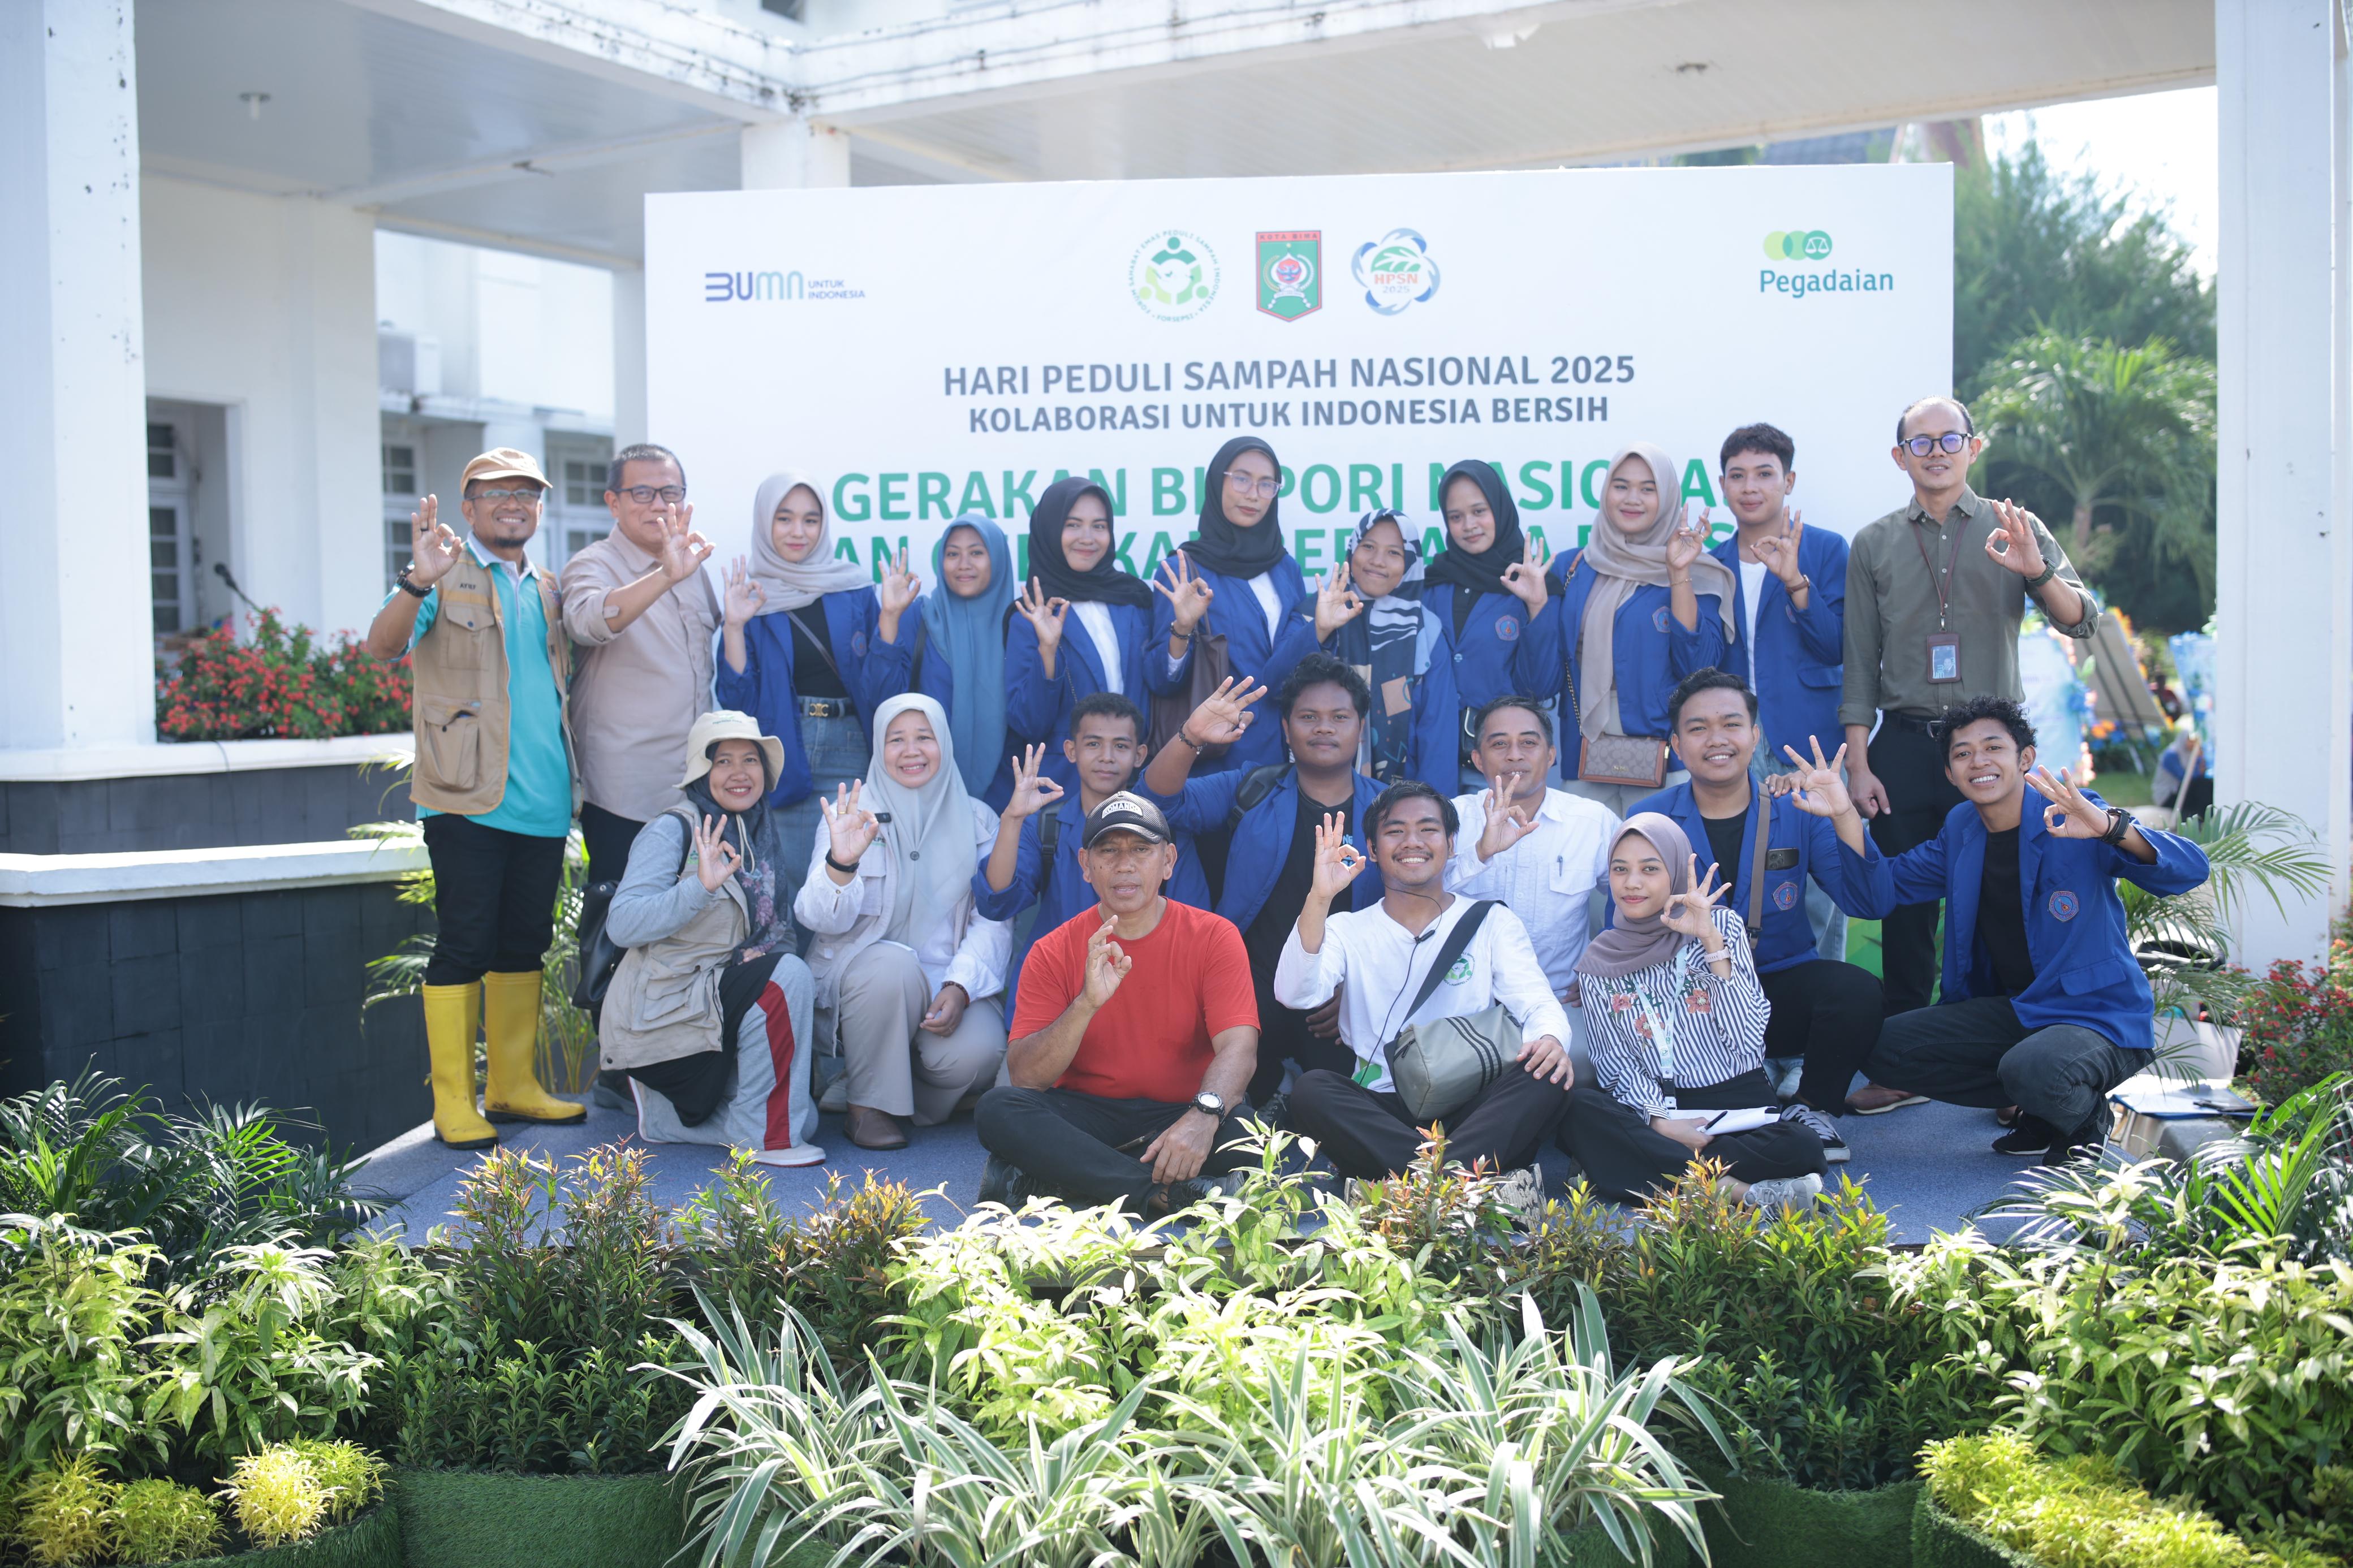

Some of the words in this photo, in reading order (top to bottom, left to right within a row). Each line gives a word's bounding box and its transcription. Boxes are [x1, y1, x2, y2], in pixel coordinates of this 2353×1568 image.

[808, 280, 844, 289] UNTUK
[1162, 229, 1194, 239] PEDULI
[1198, 267, 1220, 312] INDONESIA
[1374, 273, 1419, 284] HPSN
[1760, 269, 1894, 299] Pegadaian
[705, 271, 803, 302] BUMN
[808, 290, 865, 299] INDONESIA
[945, 366, 1028, 396] HARI
[1043, 362, 1171, 394] PEDULI
[1183, 359, 1337, 391] SAMPAH
[1351, 356, 1539, 387] NASIONAL
[1550, 355, 1635, 384] 2025
[969, 404, 1169, 433] KOLABORASI
[1182, 401, 1291, 429] UNTUK
[1302, 399, 1481, 426] INDONESIA
[1492, 396, 1608, 424] BERSIH
[832, 468, 1127, 522] GERAKN
